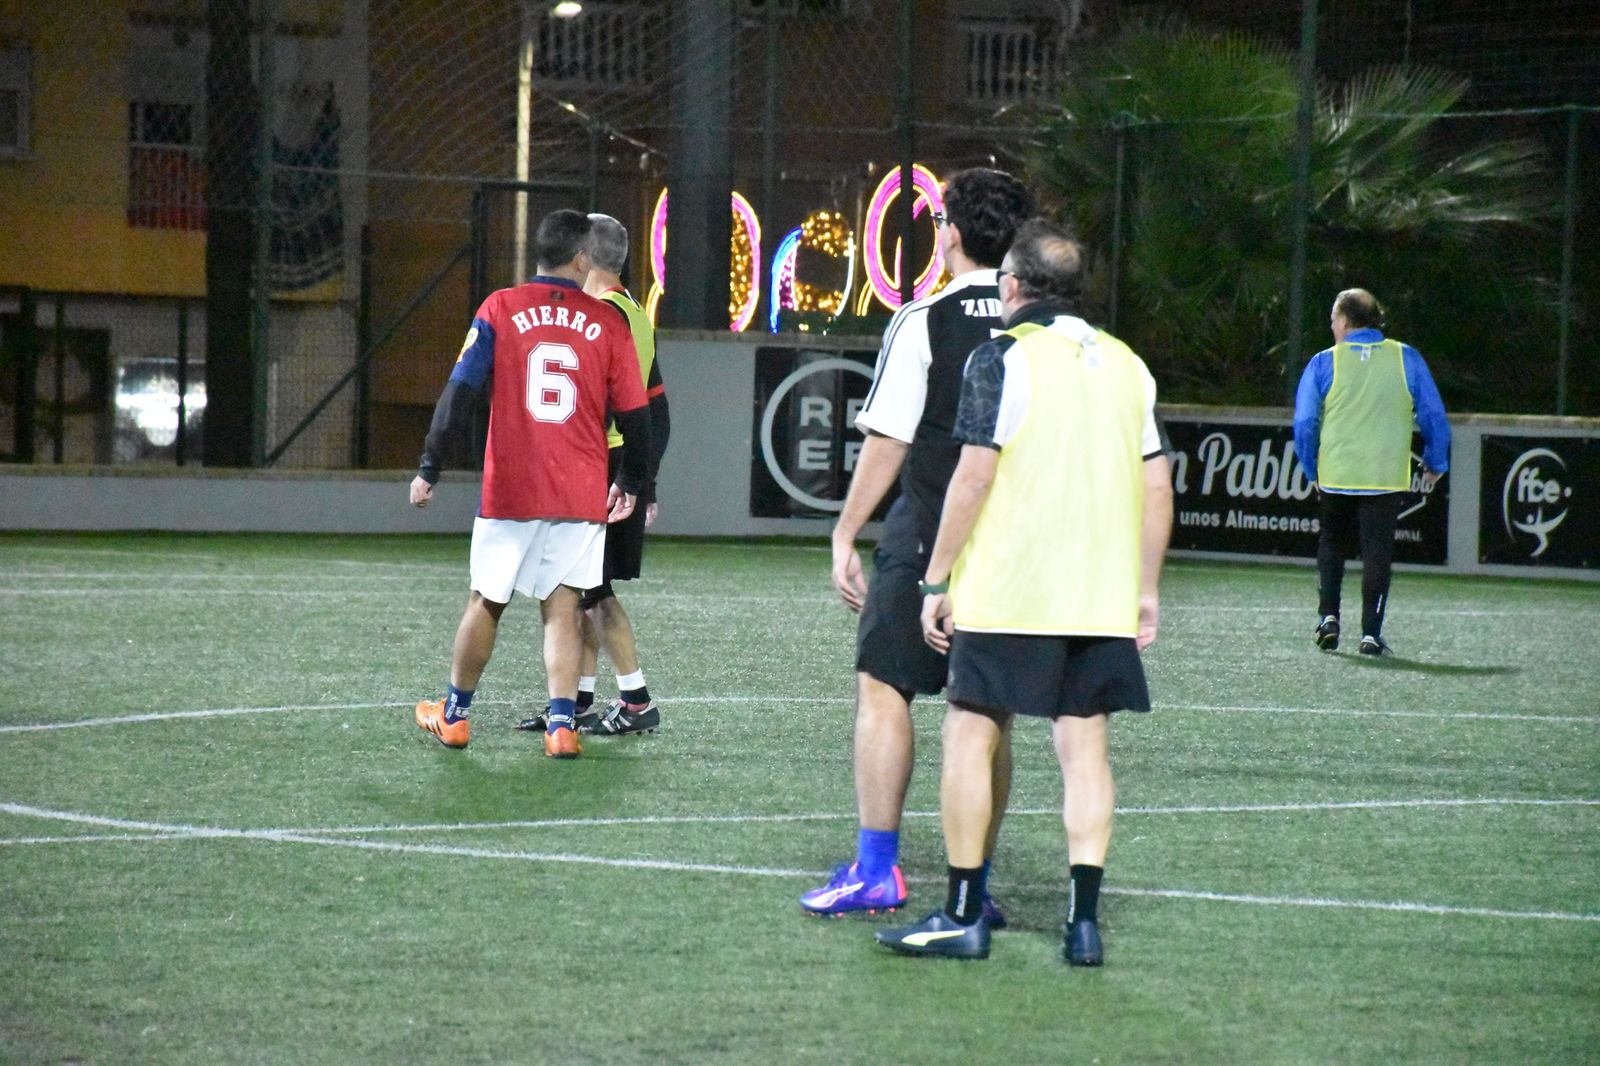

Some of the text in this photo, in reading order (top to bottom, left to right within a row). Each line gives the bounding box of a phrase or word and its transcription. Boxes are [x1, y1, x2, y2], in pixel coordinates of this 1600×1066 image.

[511, 305, 602, 341] HIERRO
[526, 341, 579, 424] 6
[1180, 510, 1320, 533] unos Almacenes
